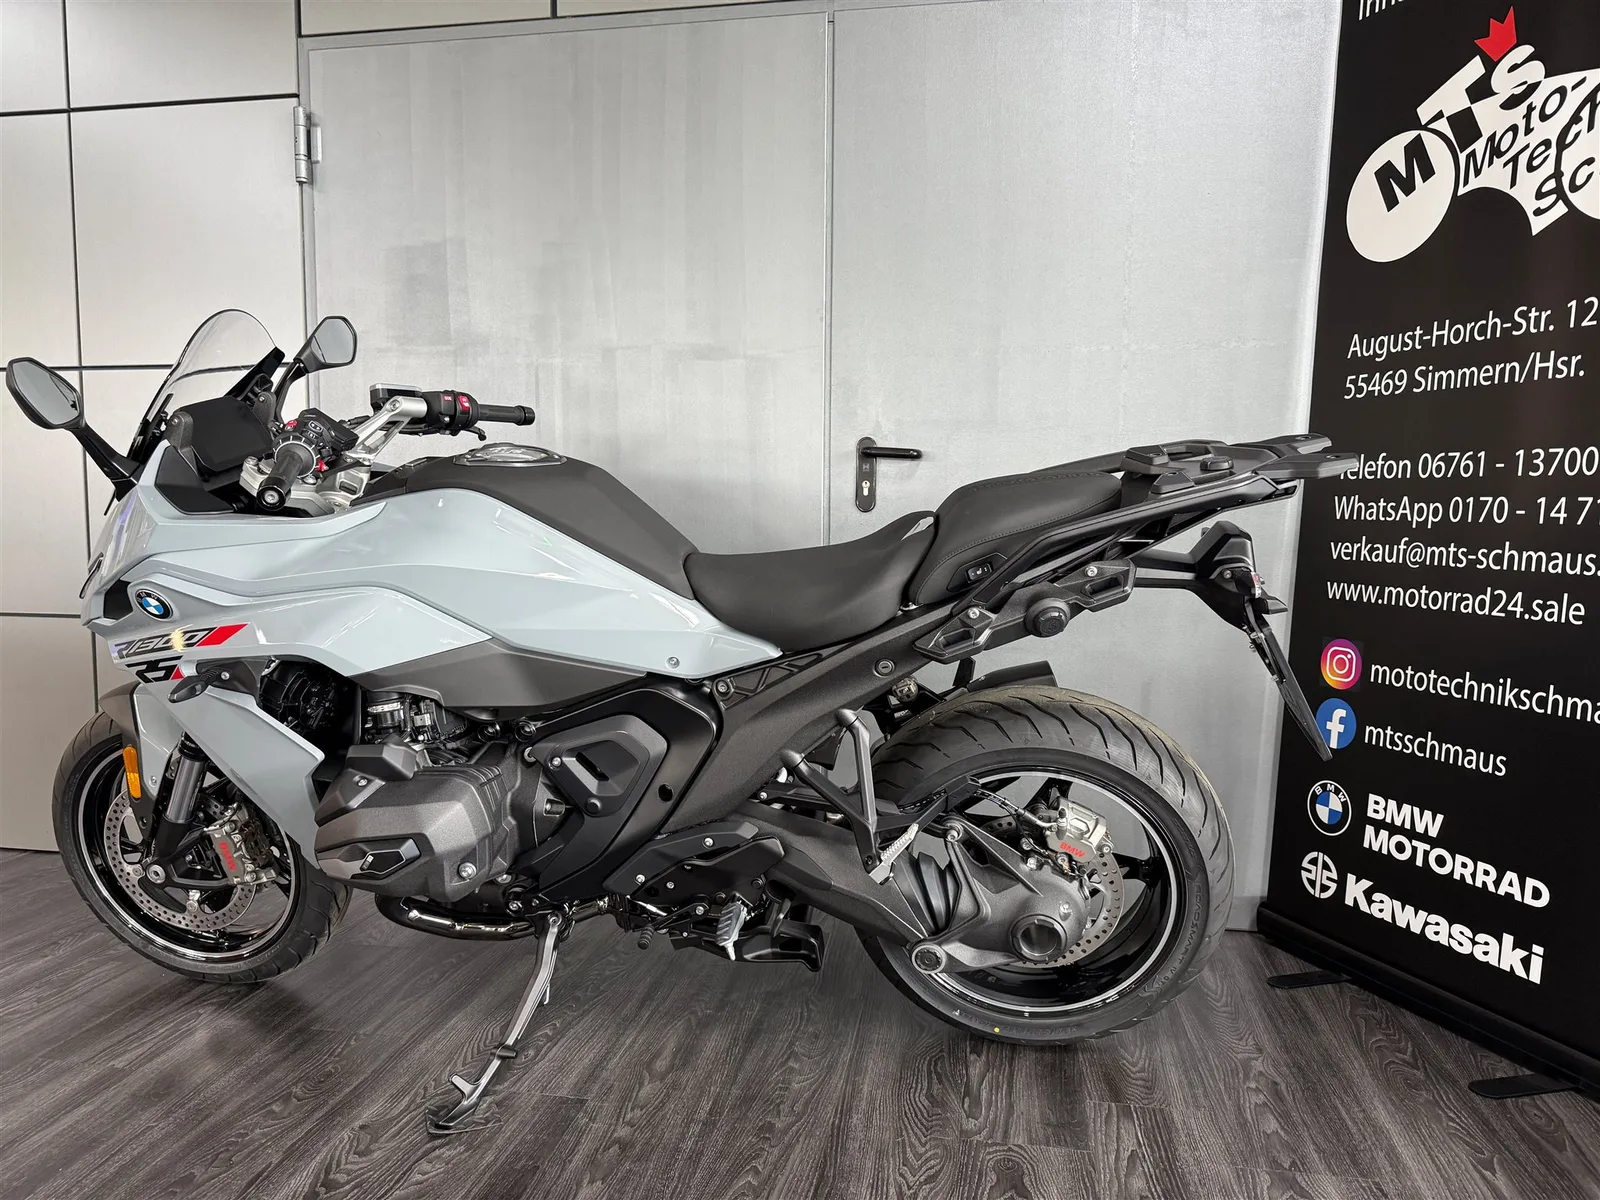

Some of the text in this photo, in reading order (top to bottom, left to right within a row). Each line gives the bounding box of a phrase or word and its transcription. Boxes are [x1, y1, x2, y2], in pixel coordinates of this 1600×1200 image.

[1347, 296, 1599, 362] August-Horch-Str. 12
[1343, 350, 1586, 400] 55469 Simmern/Hsr.
[1340, 452, 1412, 480] elefon
[1418, 451, 1487, 479] 06761
[1515, 446, 1600, 477] 13700
[1334, 494, 1443, 529] WhatsApp
[1448, 496, 1509, 524] 0170
[1536, 496, 1568, 525] 14
[1330, 535, 1600, 577] verkauf@mts-schmaus.
[1327, 581, 1586, 625] www.motorrad24.sale
[1364, 725, 1507, 777] mtsschmaus
[1366, 793, 1445, 838] BMW
[1060, 841, 1086, 858] BMW
[1363, 824, 1550, 908] MOTORRAD
[1344, 872, 1545, 985] Kawasaki
